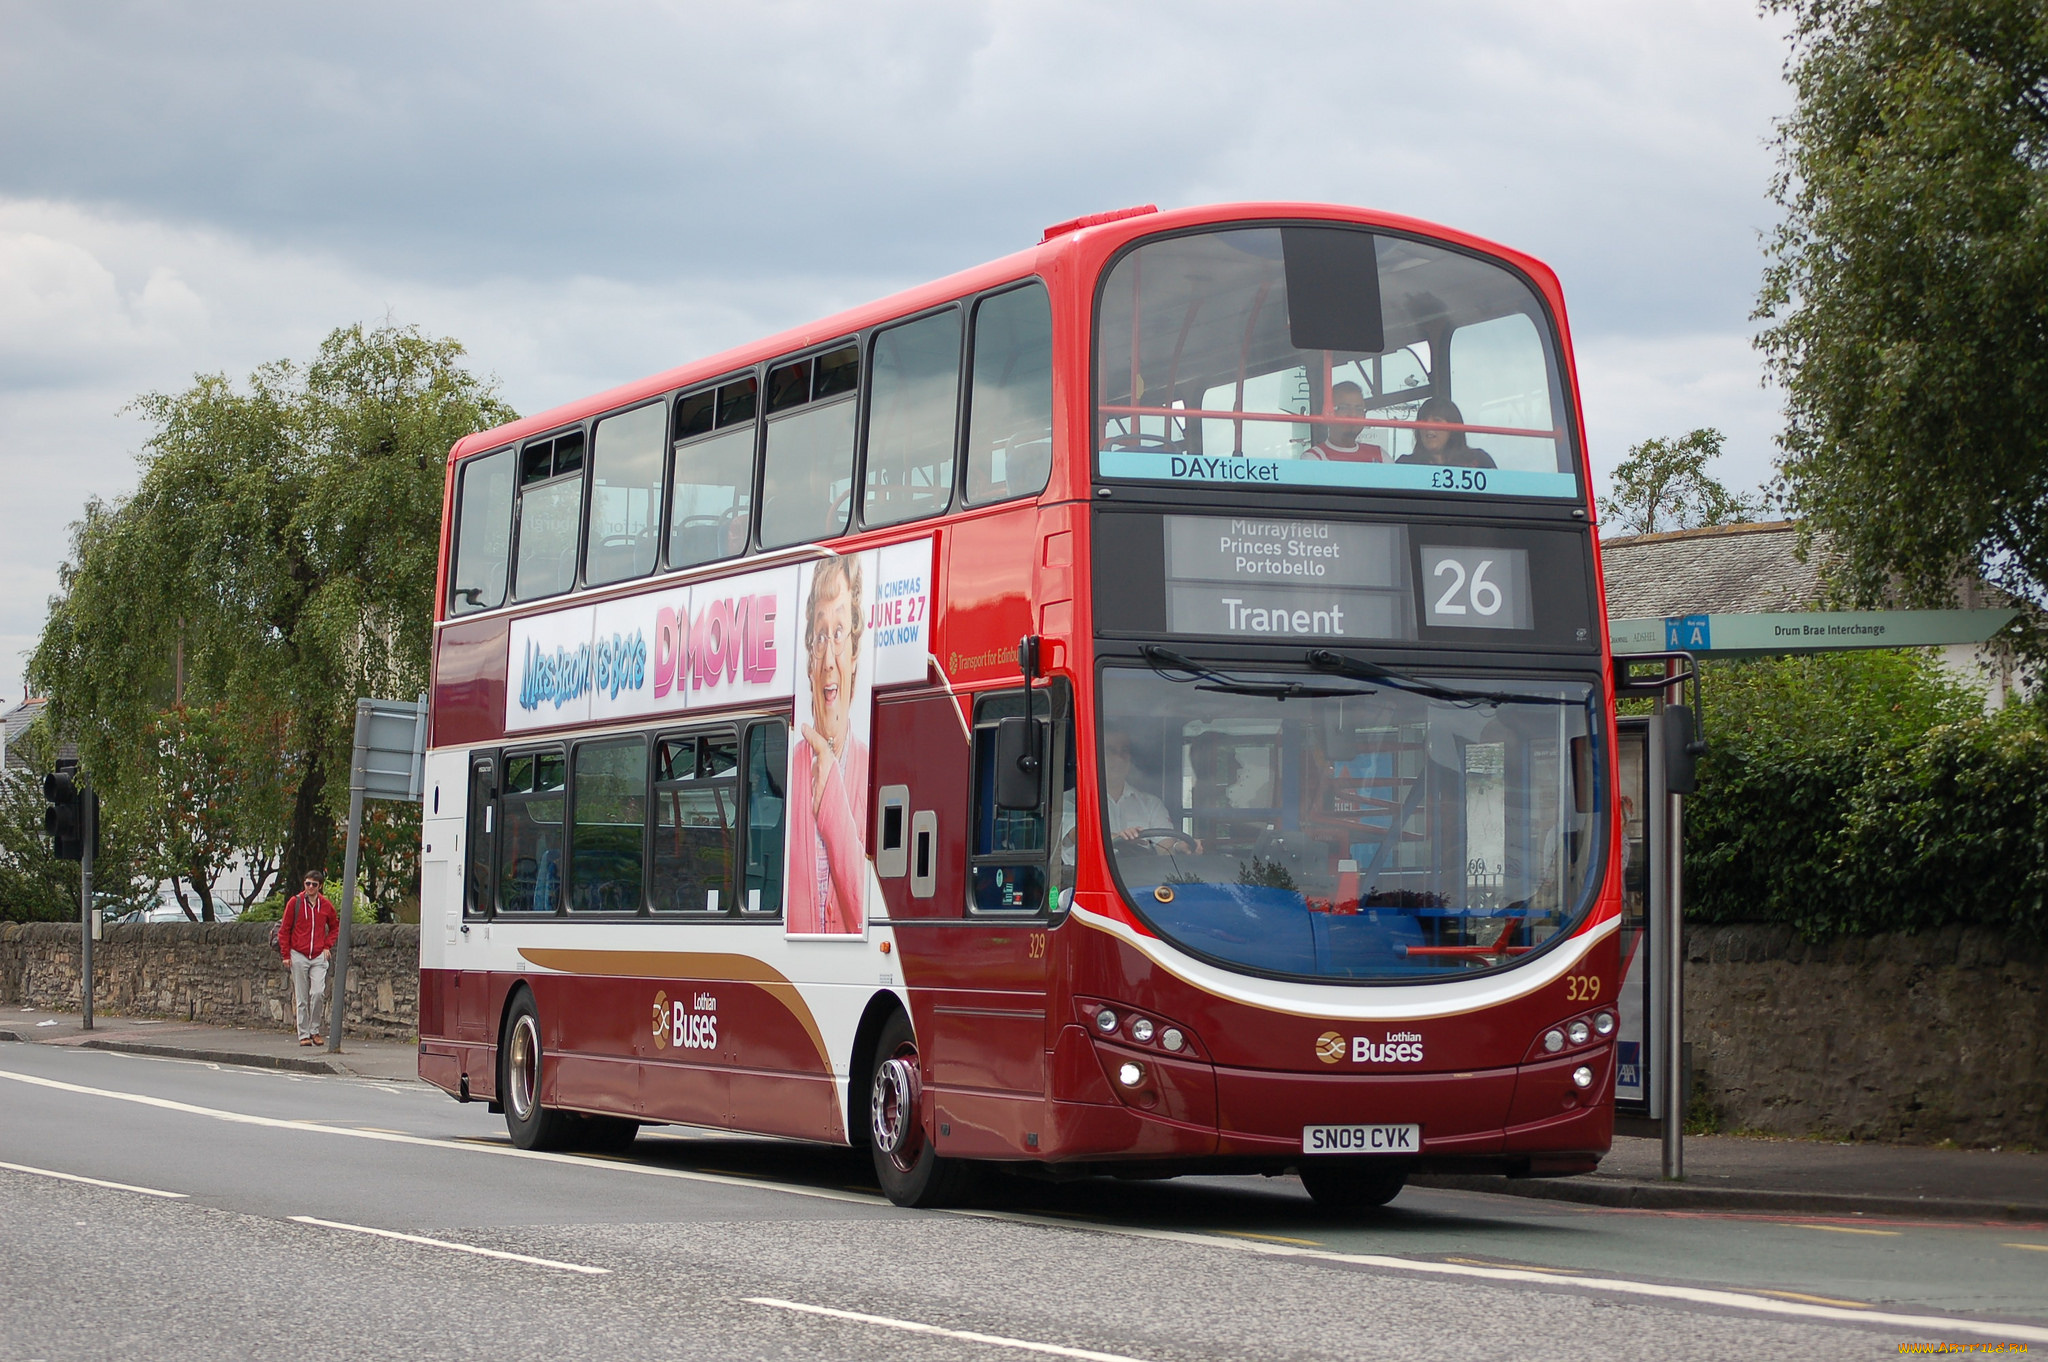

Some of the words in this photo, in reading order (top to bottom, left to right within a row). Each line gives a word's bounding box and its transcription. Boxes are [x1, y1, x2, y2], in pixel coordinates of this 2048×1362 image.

[1171, 457, 1279, 481] DAYticket
[1431, 468, 1487, 491] £3.50
[1231, 520, 1329, 540] Murrayfield
[1220, 537, 1282, 555] Princes
[1287, 540, 1340, 558] Street
[1235, 556, 1326, 576] Portobello
[884, 577, 921, 598] CINEMAS
[1433, 558, 1503, 616] 26
[867, 600, 902, 629] JUNE
[908, 595, 926, 623] 27
[1221, 598, 1344, 634] Tranent
[897, 625, 919, 645] NOW
[1671, 628, 1679, 645] A
[1690, 626, 1704, 645] A
[1774, 625, 1800, 636] Drum
[1803, 625, 1825, 635] Brae
[1827, 624, 1886, 636] Interchange
[611, 627, 646, 700] BOYS
[958, 651, 987, 671] Transport
[987, 649, 997, 666] for
[997, 645, 1020, 665] Edinbu
[1029, 933, 1046, 959] 329
[1566, 975, 1600, 1001] 329
[694, 991, 717, 1011] Lothian
[672, 1000, 717, 1050] Buses
[1386, 1031, 1422, 1043] Lothian
[1352, 1036, 1424, 1063] Buses
[1617, 1064, 1637, 1083] AXA
[1312, 1128, 1365, 1149] SN09
[1371, 1127, 1411, 1148] CVK
